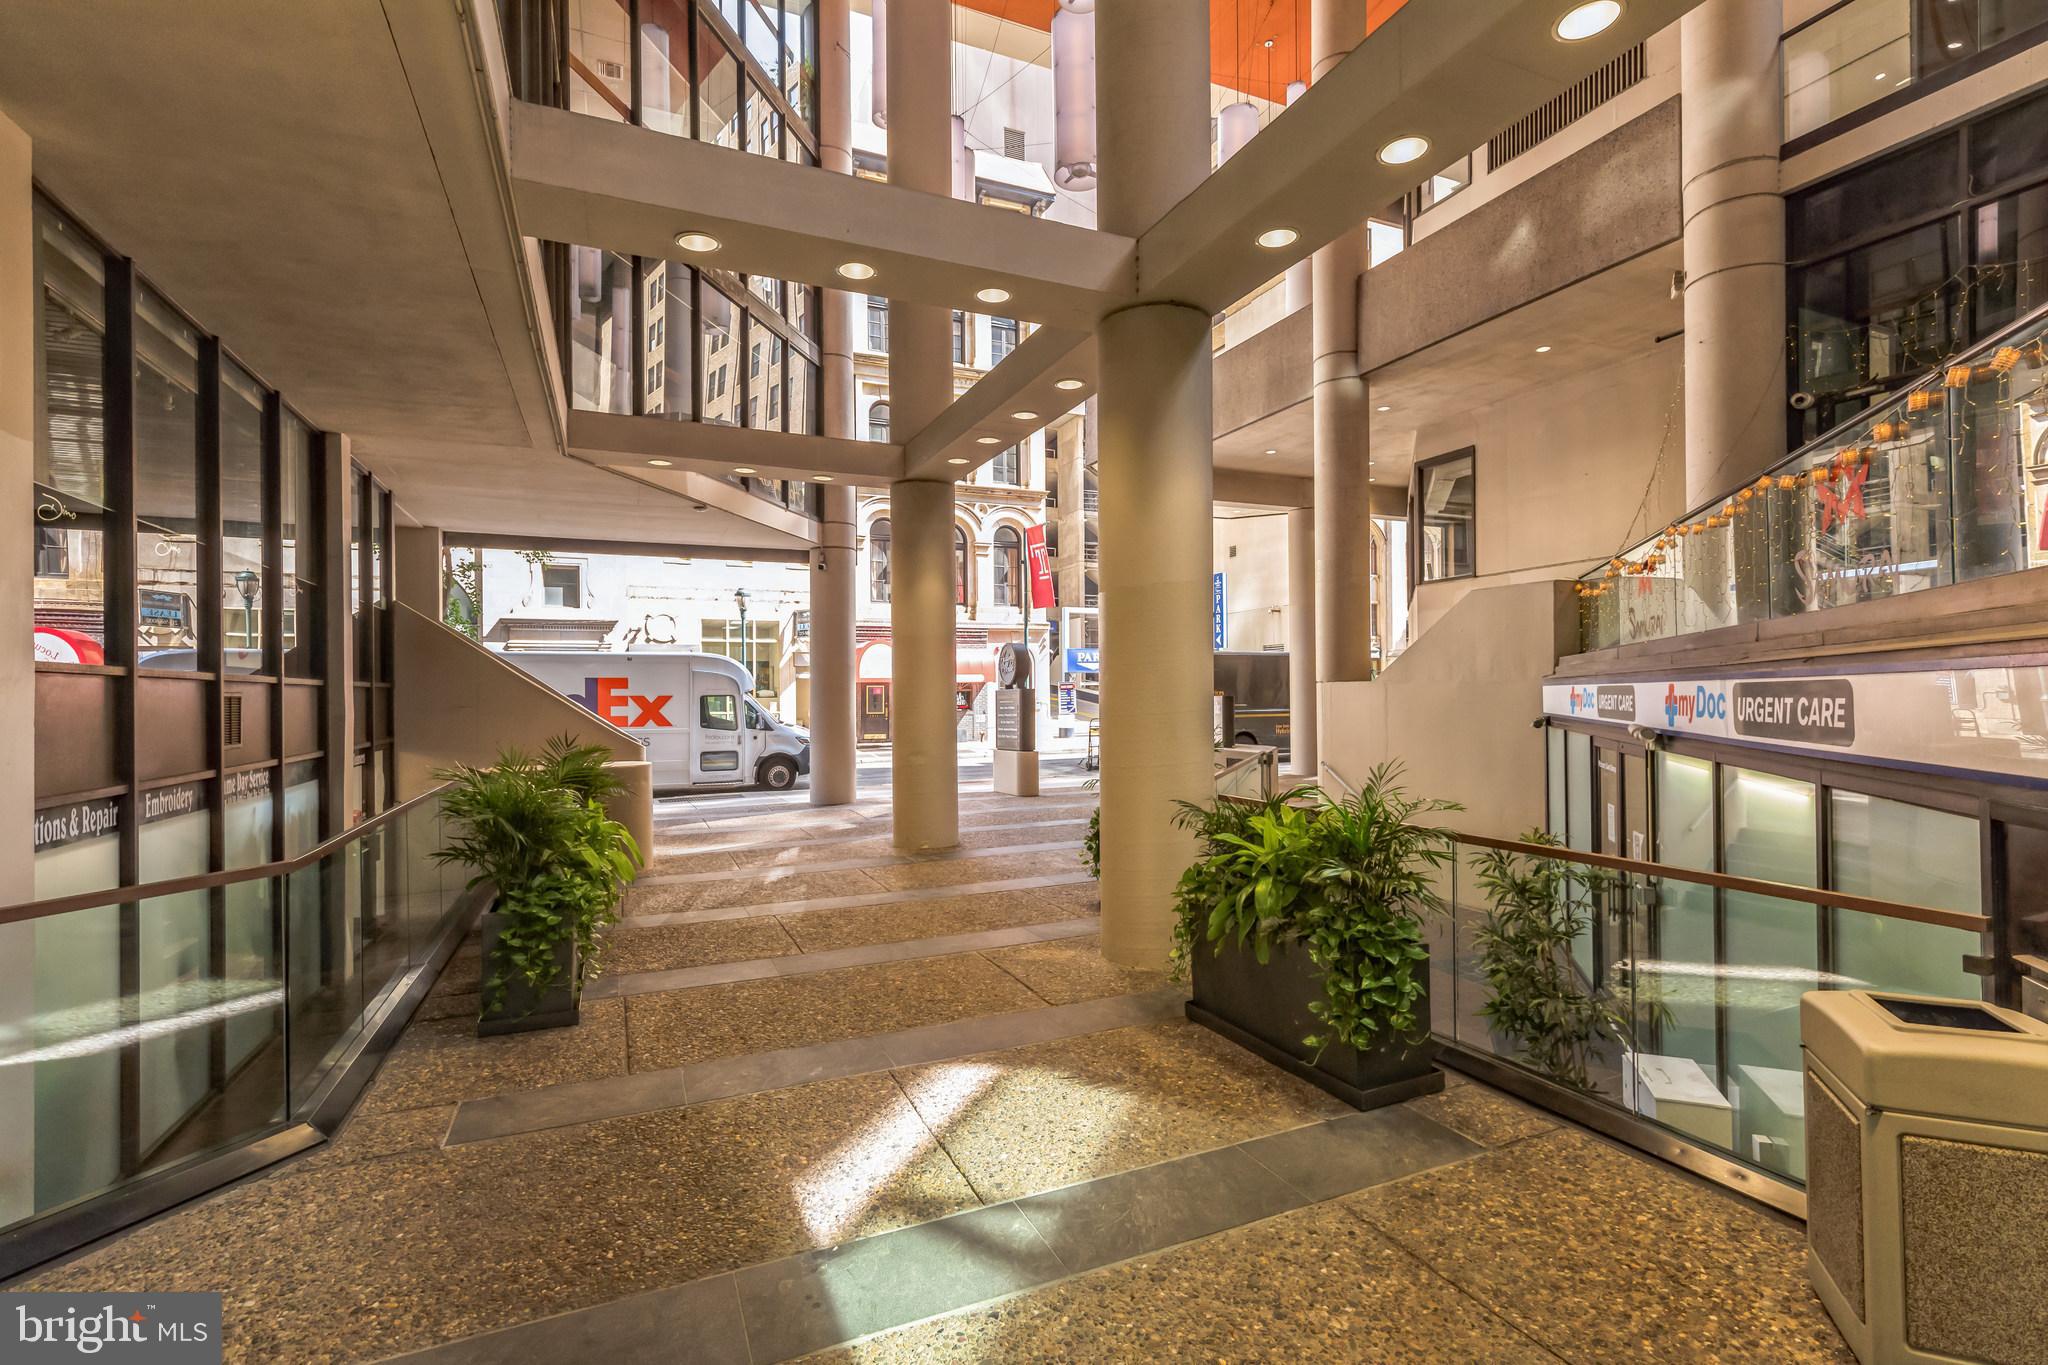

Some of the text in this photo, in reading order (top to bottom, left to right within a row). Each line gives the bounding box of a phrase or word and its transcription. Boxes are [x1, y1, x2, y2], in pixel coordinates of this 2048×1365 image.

[1576, 687, 1633, 712] myDoc URGENT CARE
[1678, 685, 1846, 728] myDoc URGENT CARE
[145, 788, 193, 818] Embroidery
[70, 807, 79, 837] &
[82, 802, 118, 836] Repair
